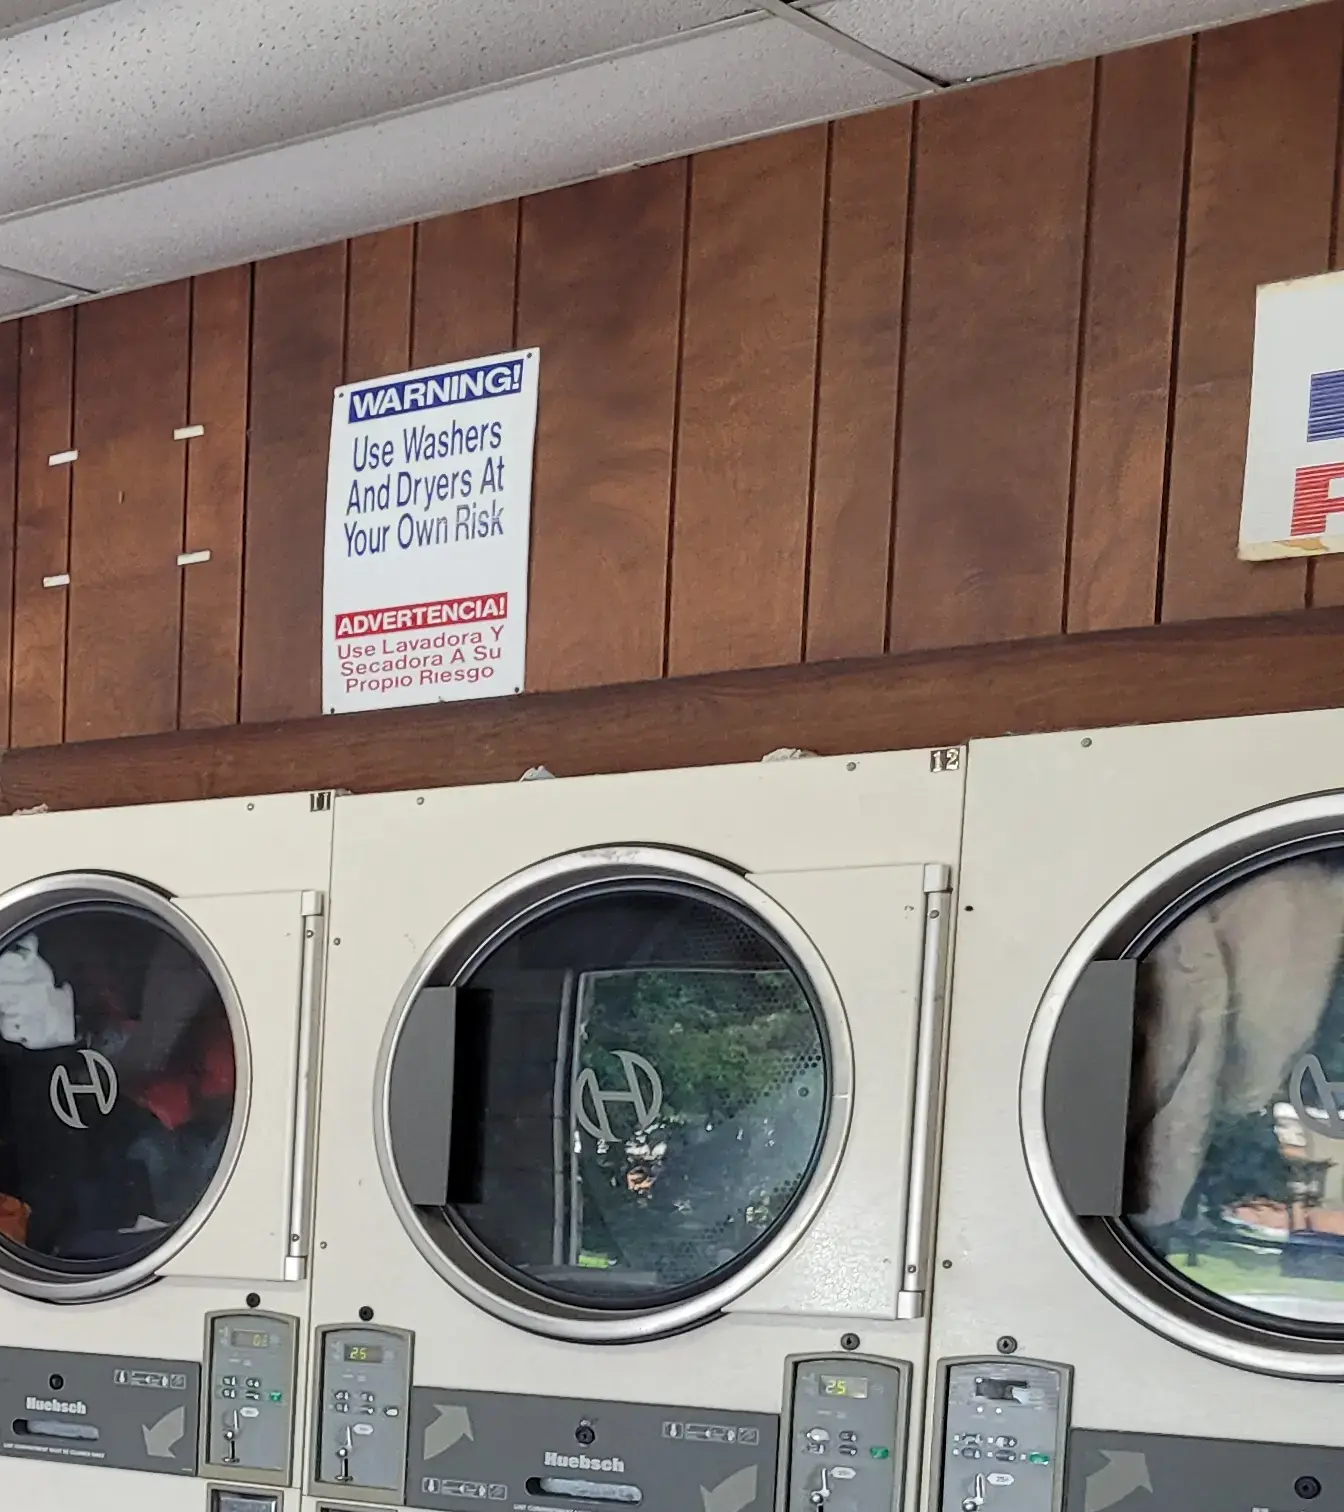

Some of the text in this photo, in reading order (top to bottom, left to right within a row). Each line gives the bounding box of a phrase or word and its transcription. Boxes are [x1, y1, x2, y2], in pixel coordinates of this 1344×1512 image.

[352, 364, 521, 419] WARNING!
[353, 420, 502, 473] Use Washers
[346, 456, 505, 516] And Dryers At
[344, 500, 505, 557] Your Own Risk
[337, 597, 505, 636] ADVERTENCIA!
[337, 624, 504, 660] Use Lavadora Y
[341, 645, 501, 677] Secadora A Su
[346, 666, 494, 693] Propio Riesgo
[933, 748, 959, 772] 12
[349, 1347, 367, 1360] 25
[825, 1380, 846, 1395] 25
[26, 1396, 87, 1415] Huebsch
[544, 1452, 625, 1473] Huebsch
